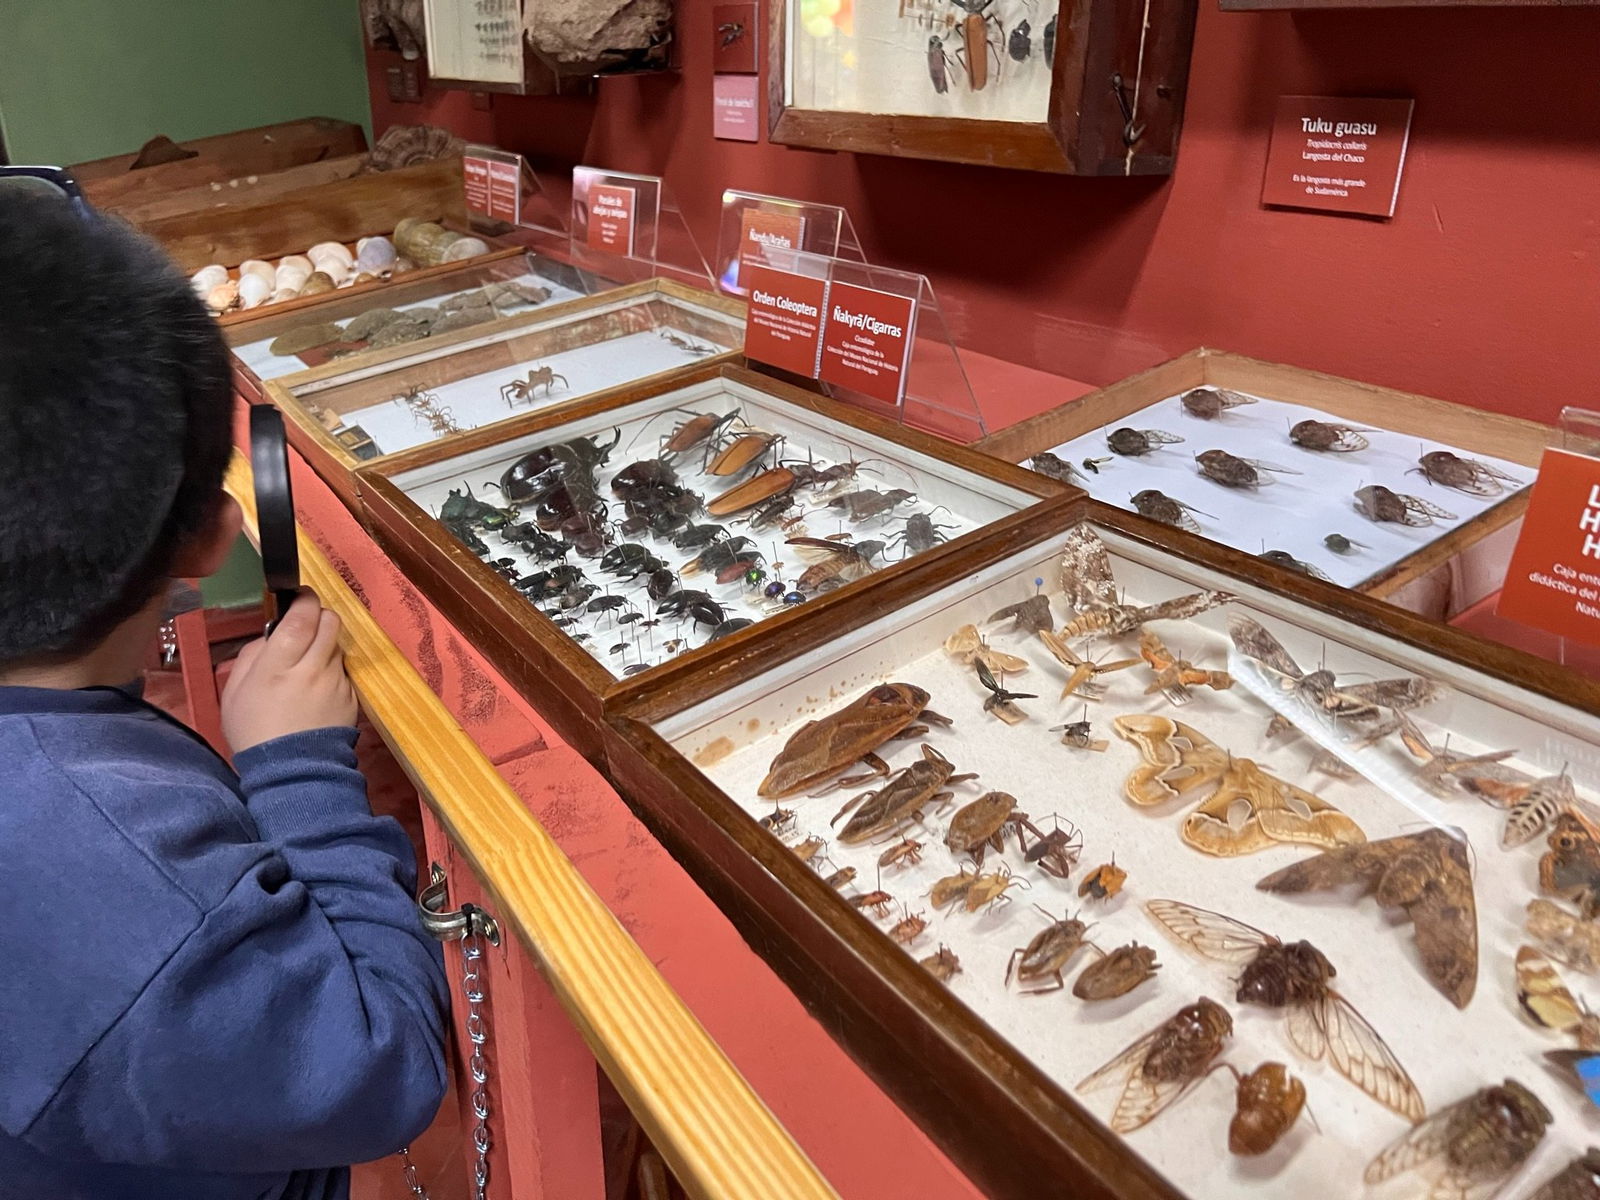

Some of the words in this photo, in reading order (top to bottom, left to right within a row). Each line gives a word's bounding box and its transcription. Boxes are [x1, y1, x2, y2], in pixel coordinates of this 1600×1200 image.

[1301, 117, 1332, 134] Tuku
[1334, 122, 1377, 137] guasu
[1302, 151, 1331, 162] Langosta
[1331, 153, 1343, 161] del
[1343, 154, 1365, 163] Chaco
[753, 290, 776, 306] Orden
[776, 296, 818, 317] Coleoptera
[833, 305, 902, 338] Ñakyrã/Cigarras
[1553, 563, 1577, 579] Caja
[1529, 571, 1577, 595] didáctica
[1578, 587, 1598, 601] del
